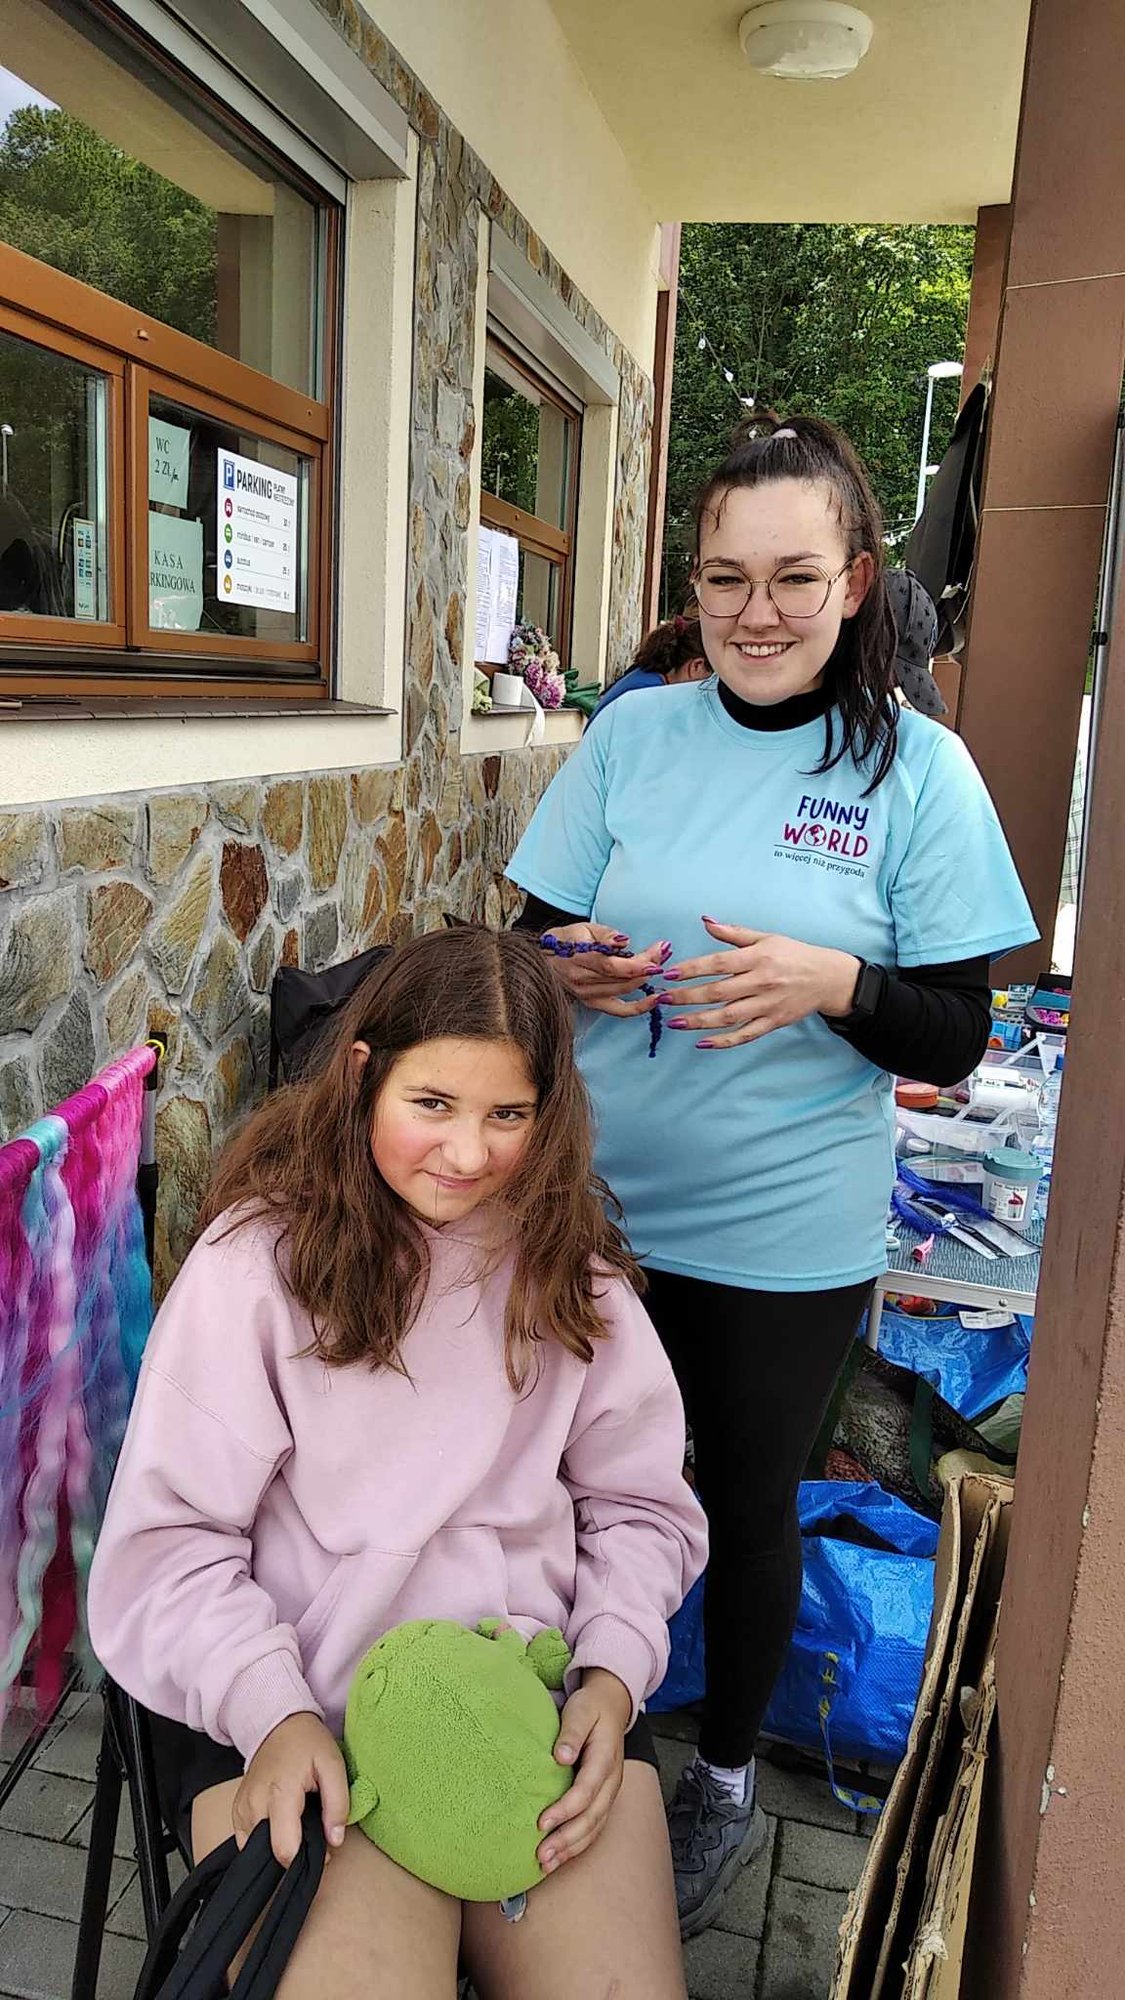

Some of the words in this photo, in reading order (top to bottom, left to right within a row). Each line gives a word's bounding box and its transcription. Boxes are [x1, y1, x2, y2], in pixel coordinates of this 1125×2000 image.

[155, 436, 170, 454] WC
[154, 458, 160, 474] 2
[236, 469, 273, 500] PARKING
[154, 549, 184, 570] KASA
[149, 571, 195, 594] RKINGOWA
[796, 794, 869, 831] FUNNY
[773, 850, 783, 858] to
[785, 852, 811, 865] więcej
[826, 861, 865, 878] przygoda
